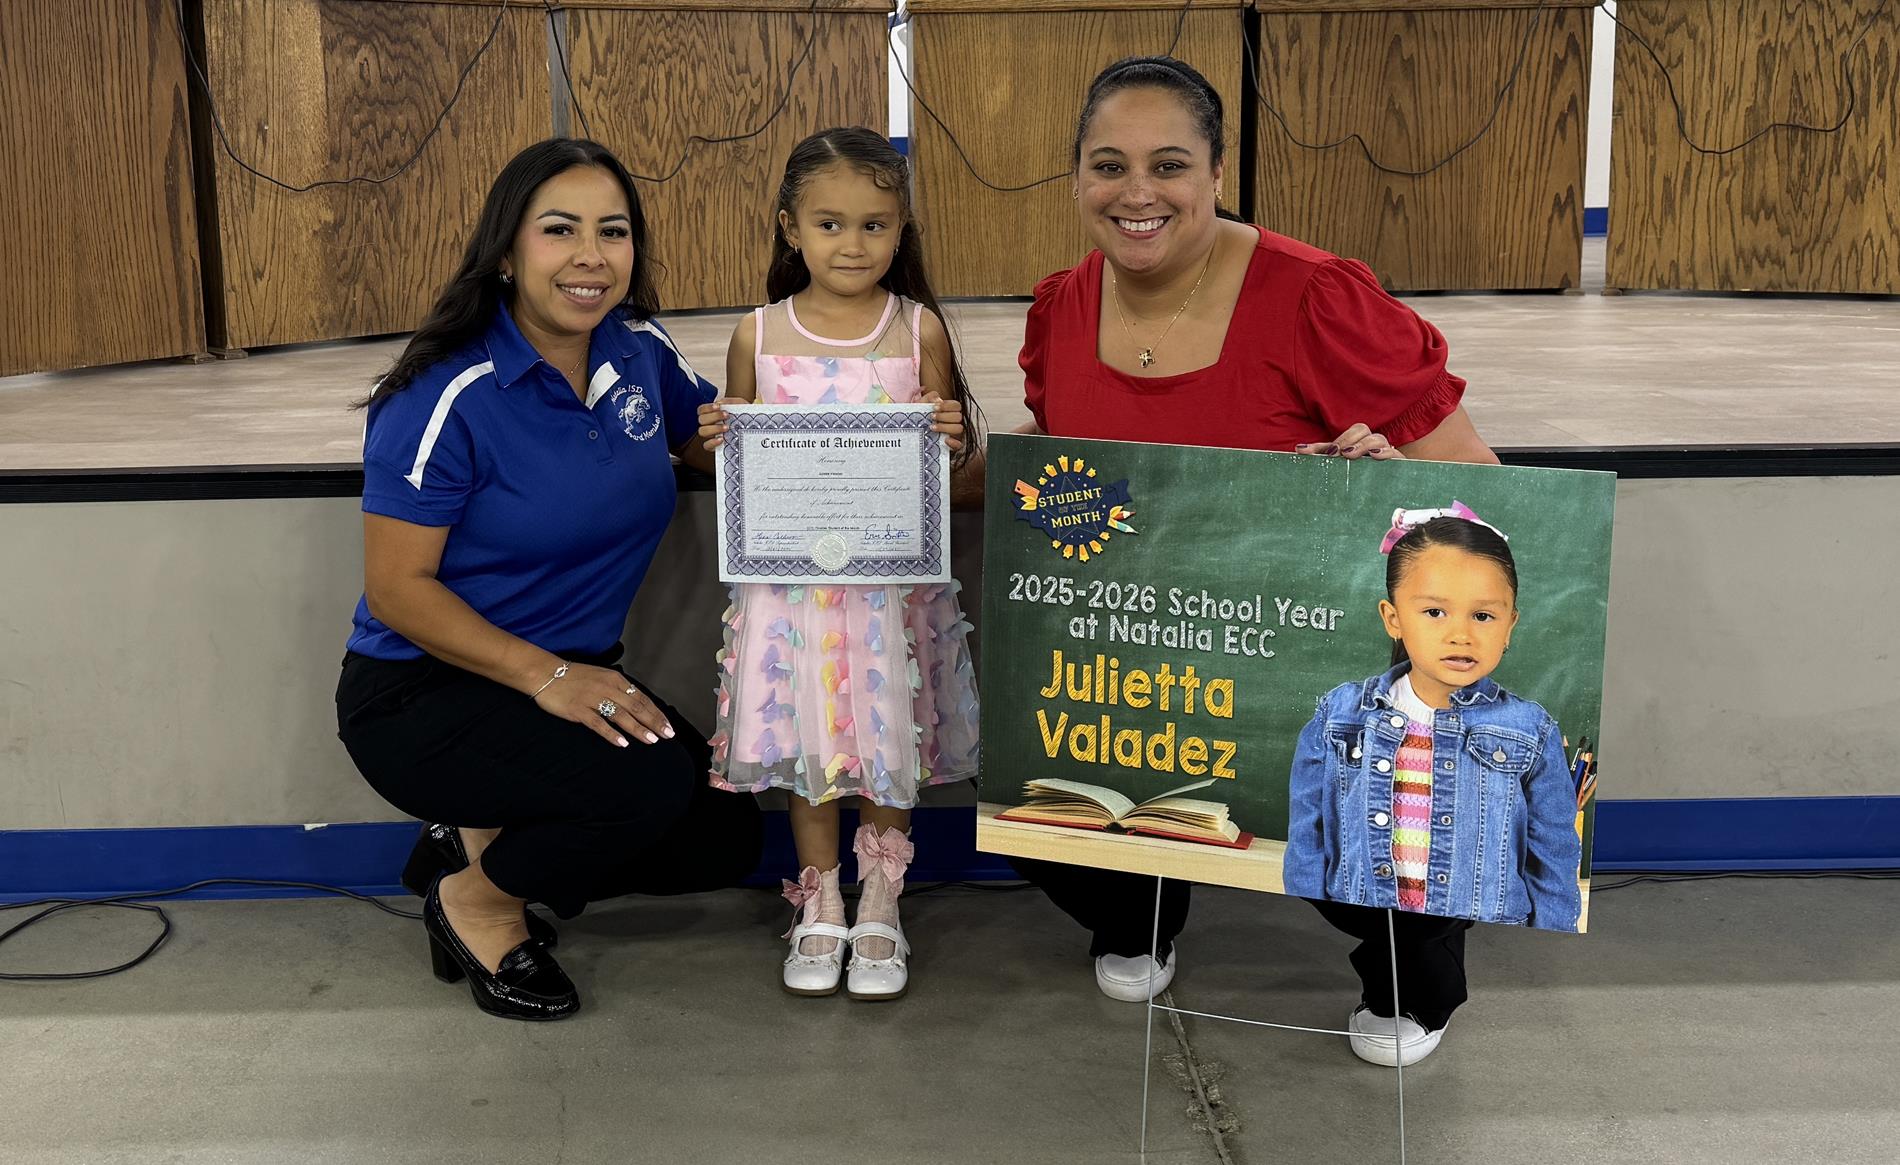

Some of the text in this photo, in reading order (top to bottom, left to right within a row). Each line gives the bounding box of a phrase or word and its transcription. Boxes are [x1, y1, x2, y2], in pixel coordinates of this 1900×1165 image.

[628, 384, 643, 394] ISD
[760, 437, 901, 449] Certificate of Achievement
[1038, 487, 1102, 508] STUDENT
[1051, 510, 1102, 529] MONTH
[1008, 572, 1346, 632] 2025-2026 School Year
[1068, 612, 1277, 659] at Natalia ECC
[1040, 649, 1236, 719] Julietta
[1035, 708, 1238, 780] Valadez
